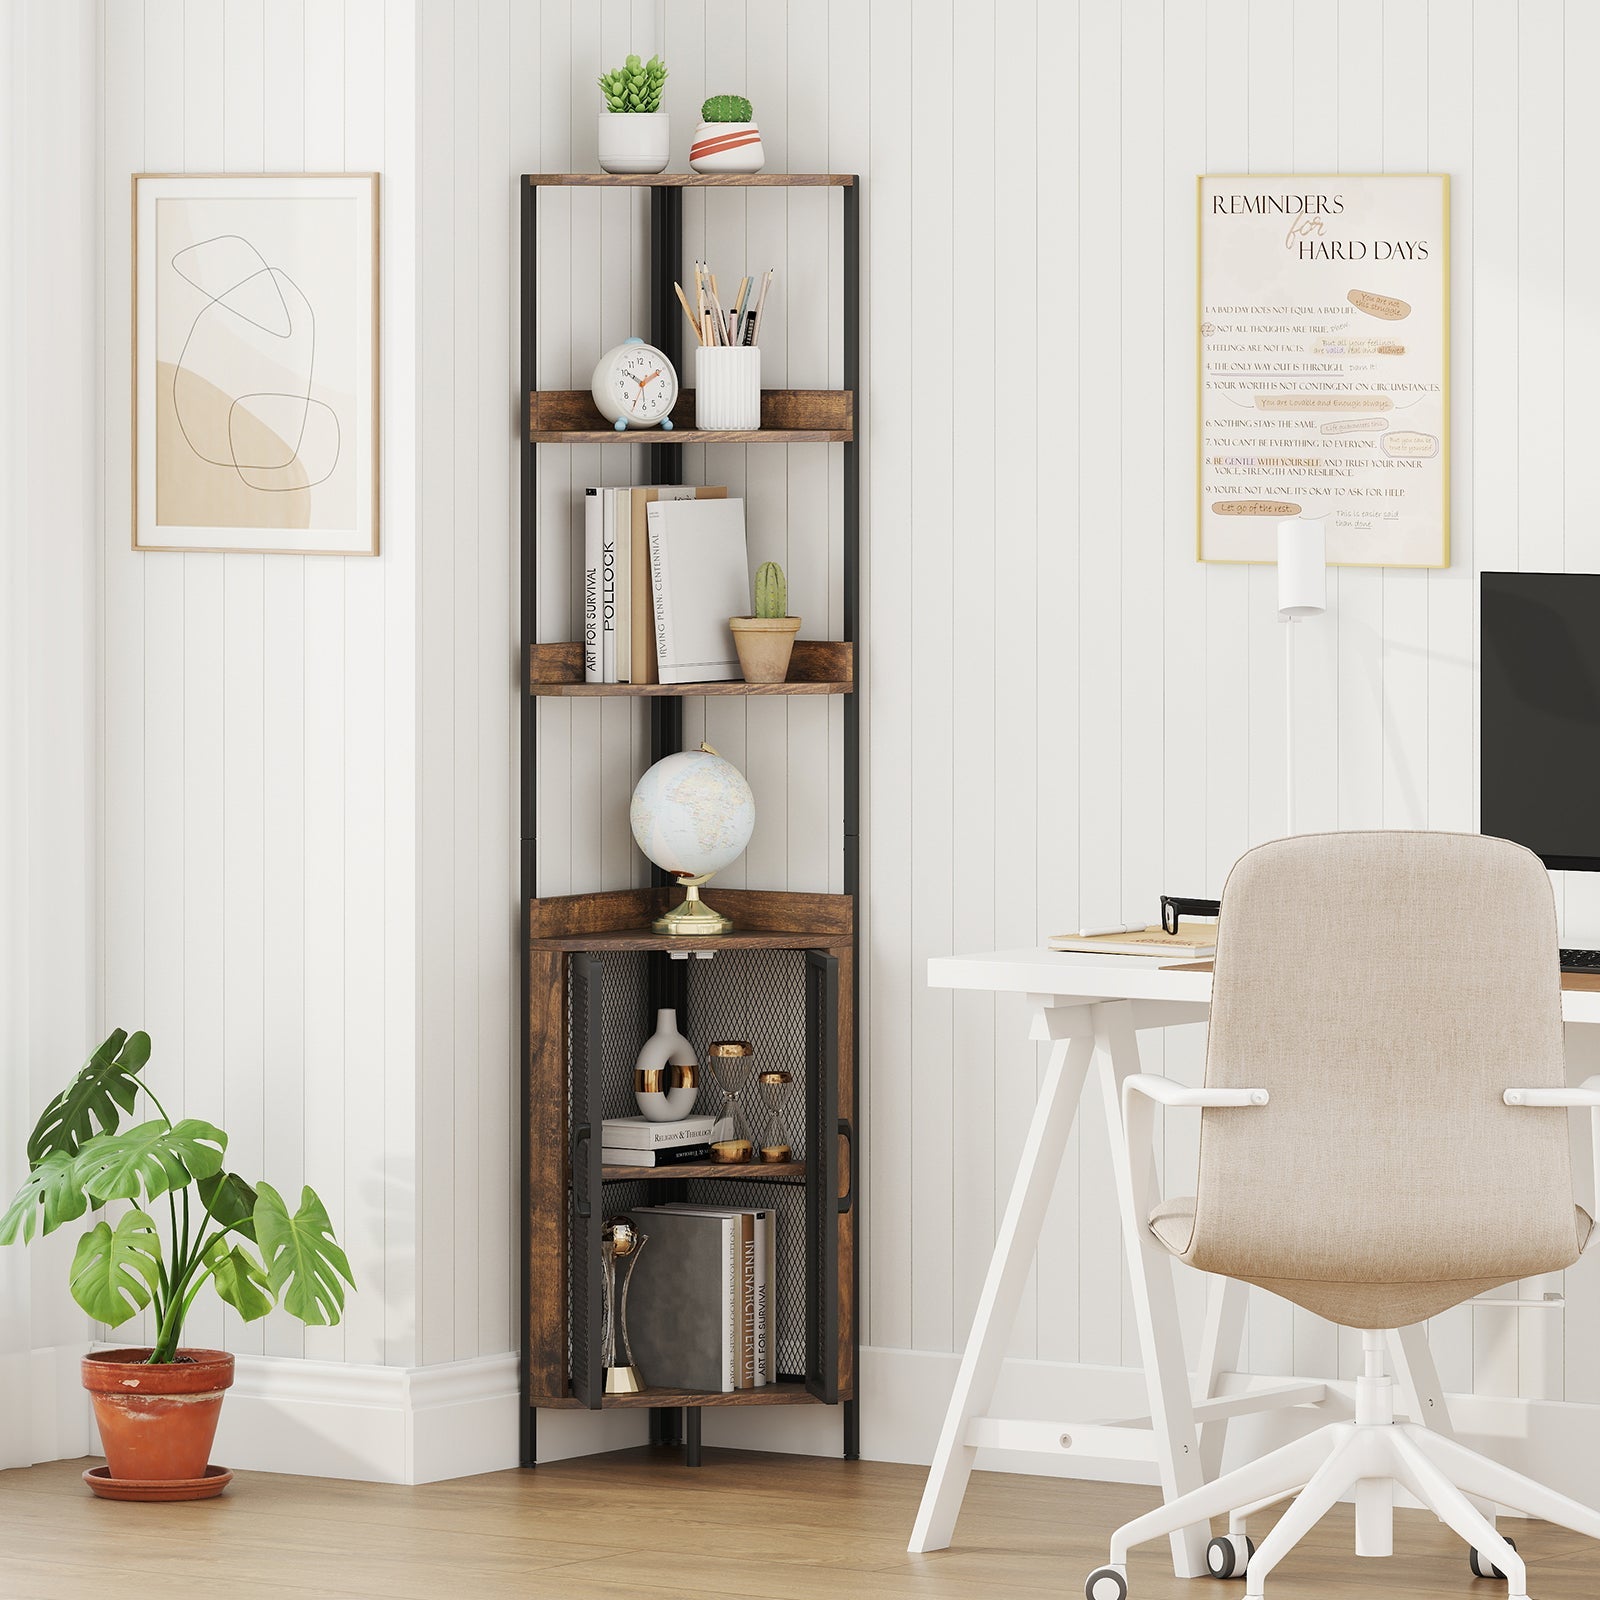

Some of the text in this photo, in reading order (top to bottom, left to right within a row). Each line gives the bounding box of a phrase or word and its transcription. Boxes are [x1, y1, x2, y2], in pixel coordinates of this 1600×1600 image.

[1212, 194, 1345, 214] REMINDERS
[1286, 209, 1327, 250] for
[1298, 240, 1429, 260] HARD DAYS
[1361, 293, 1374, 302] You
[1376, 296, 1386, 304] are
[1212, 306, 1217, 314] A
[1218, 306, 1234, 314] BAD
[1234, 306, 1249, 314] DAY
[1250, 306, 1271, 314] DOES
[1272, 306, 1288, 314] NOT
[1290, 307, 1314, 315] EQUAL
[1217, 325, 1232, 333] NOT
[1236, 325, 1248, 333] ALL
[1206, 344, 1305, 352] 3. FEELINGS ARE NOT FACTS.
[636, 358, 644, 366] 12
[1206, 363, 1212, 371] 4.
[1214, 363, 1228, 371] THE
[1230, 363, 1252, 371] ONLY
[1254, 363, 1272, 371] WAY
[1273, 363, 1291, 371] OUT
[1292, 363, 1300, 371] IS
[621, 369, 629, 377] 10
[660, 380, 665, 388] 3
[1206, 382, 1212, 390] 5.
[1213, 382, 1236, 390] YOUR
[1238, 382, 1270, 390] WORTH
[1270, 382, 1278, 390] IS
[1298, 383, 1353, 391] CONTINGENT
[1355, 383, 1369, 391] ON
[1370, 383, 1440, 391] CIRCUMSTANCES.
[624, 392, 629, 400] 8
[632, 400, 636, 408] 7
[642, 403, 647, 411] 6
[1333, 400, 1361, 408] Enough
[1254, 420, 1276, 428] STAYS
[1206, 439, 1377, 448] 7. YOU CAN'T BE EVERYTHING TO EVERYONE.
[1258, 458, 1280, 466] WITH
[1323, 459, 1342, 467] AND
[1345, 459, 1369, 467] TRUST
[1371, 459, 1395, 467] YOUR
[1396, 459, 1423, 468] INNER
[1214, 467, 1354, 476] VOICE, STRENGTH AND RESILIENCE.
[1206, 486, 1212, 494] 9.
[1213, 486, 1243, 494] YOU'RE
[1244, 486, 1262, 494] NOT
[1309, 487, 1332, 495] OKAY
[1334, 488, 1346, 496] TO
[1347, 488, 1364, 496] ASK
[1365, 488, 1383, 496] FOR
[1384, 488, 1405, 496] HELP.
[1221, 502, 1293, 514] Let go of the rest.
[1384, 510, 1399, 518] said
[603, 541, 614, 632] POLLOCK
[652, 534, 668, 658] IRVING PENN: CENTENNIAL
[586, 568, 597, 672] ART FOR SURVIVAL
[679, 1130, 684, 1140] &
[745, 1240, 754, 1380] INNENARCHITEKTUR
[758, 1283, 766, 1376] ART FOR SURVIVAL
